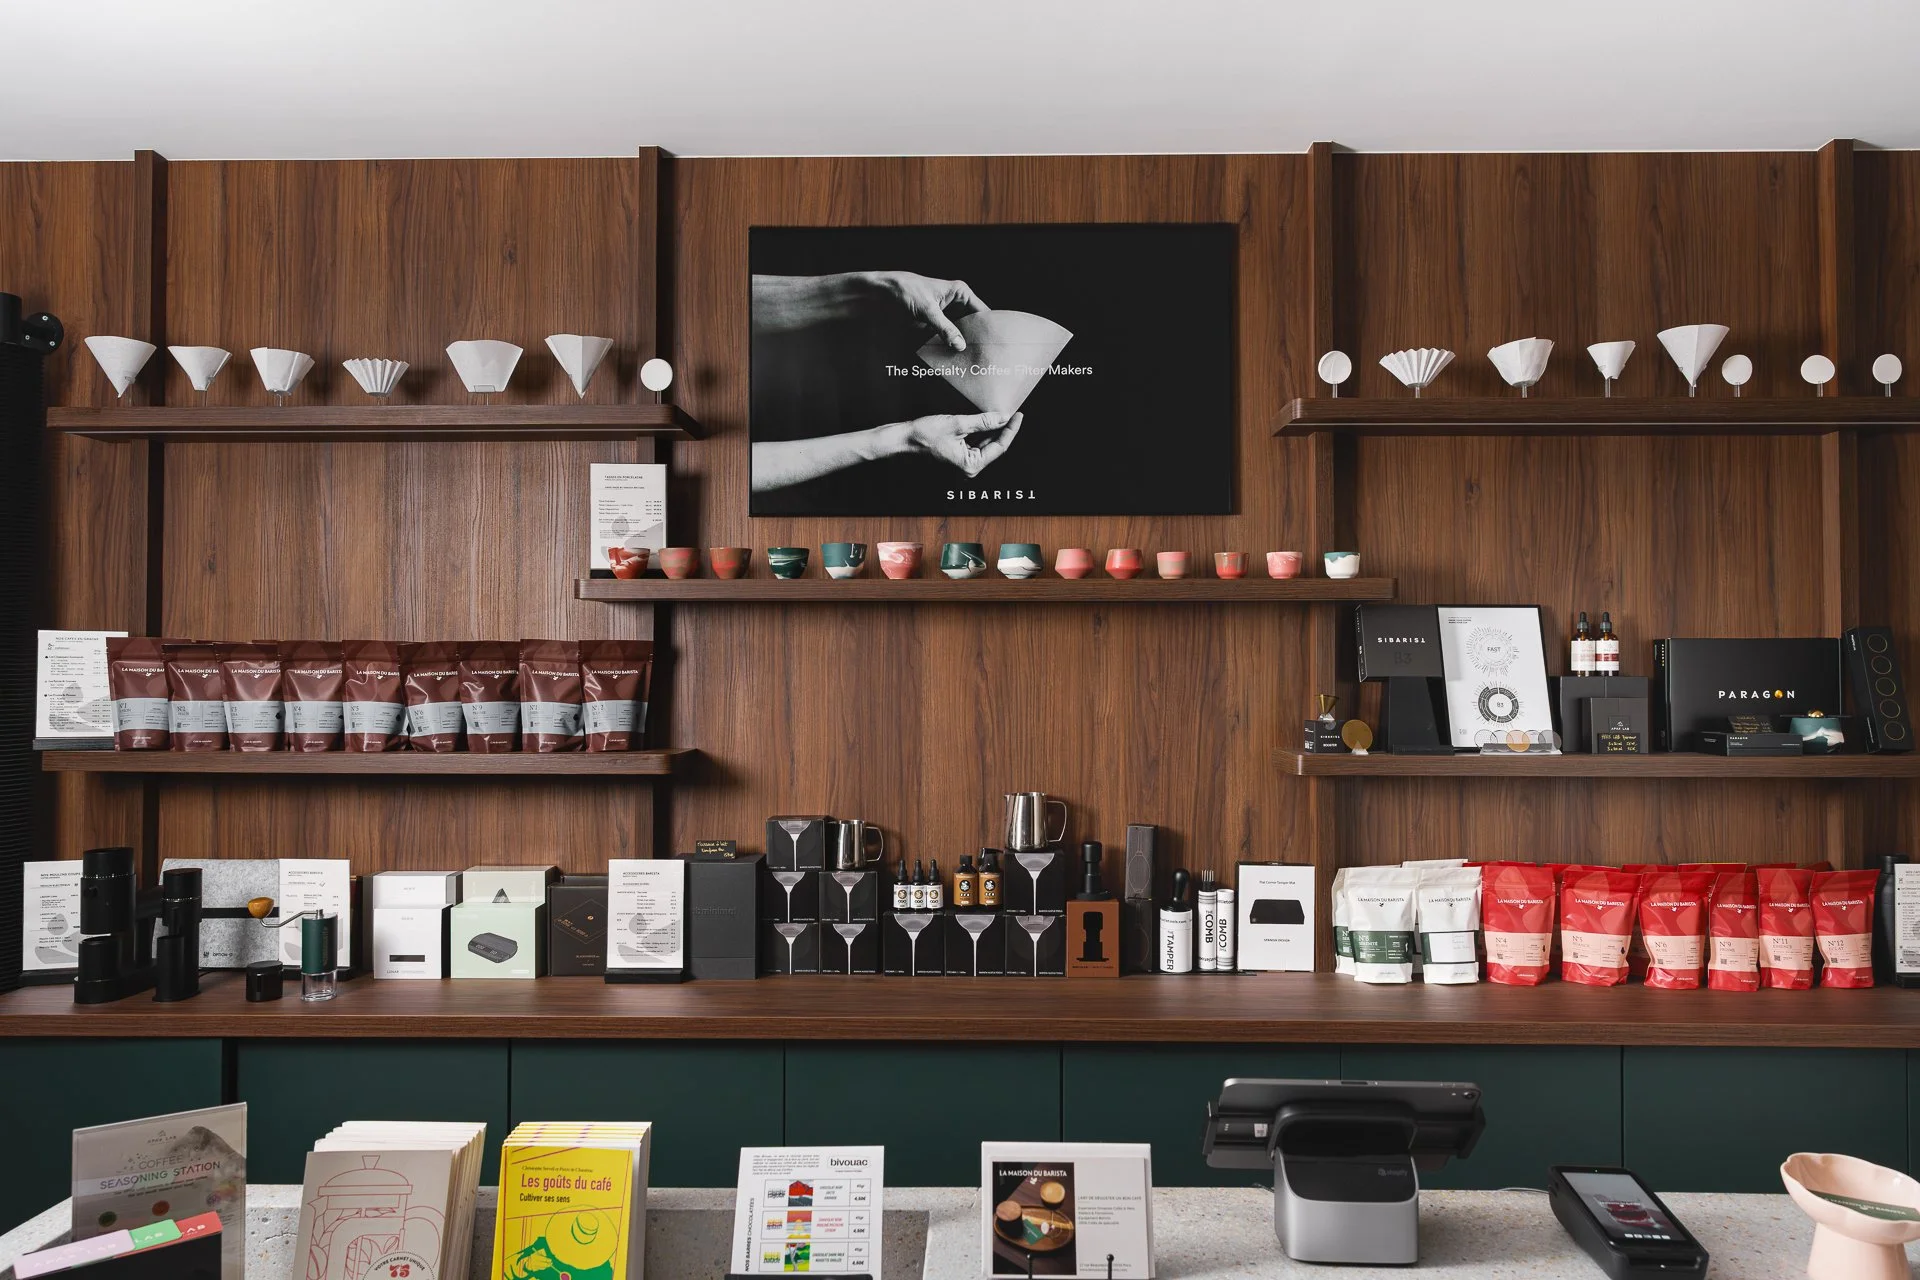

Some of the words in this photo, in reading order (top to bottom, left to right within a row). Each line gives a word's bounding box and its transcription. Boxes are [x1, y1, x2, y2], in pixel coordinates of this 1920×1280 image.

[885, 365, 908, 376] The
[911, 365, 967, 378] Specialty
[970, 365, 1009, 376] Coffee
[1015, 365, 1046, 376] Filter
[1049, 365, 1093, 376] Makers
[1205, 914, 1214, 943] COMB
[1218, 919, 1227, 948] COMB
[1166, 935, 1175, 970] TAMPER
[138, 1154, 185, 1170] COFFEE
[830, 1157, 869, 1167] bivouac
[100, 1171, 169, 1190] SEASONING
[173, 1160, 221, 1178] STATION
[999, 1169, 1008, 1177] LA
[521, 1173, 540, 1188] Les
[543, 1174, 572, 1192] goûts
[575, 1176, 587, 1190] du
[590, 1176, 613, 1192] café
[519, 1192, 543, 1202] Cultiver
[556, 1195, 571, 1203] sens
[134, 1232, 164, 1243] LAB
[373, 1259, 390, 1273] VOTRE
[389, 1255, 409, 1264] CARNET
[408, 1256, 427, 1271] UNIQUE
[388, 1263, 411, 1279] 75
